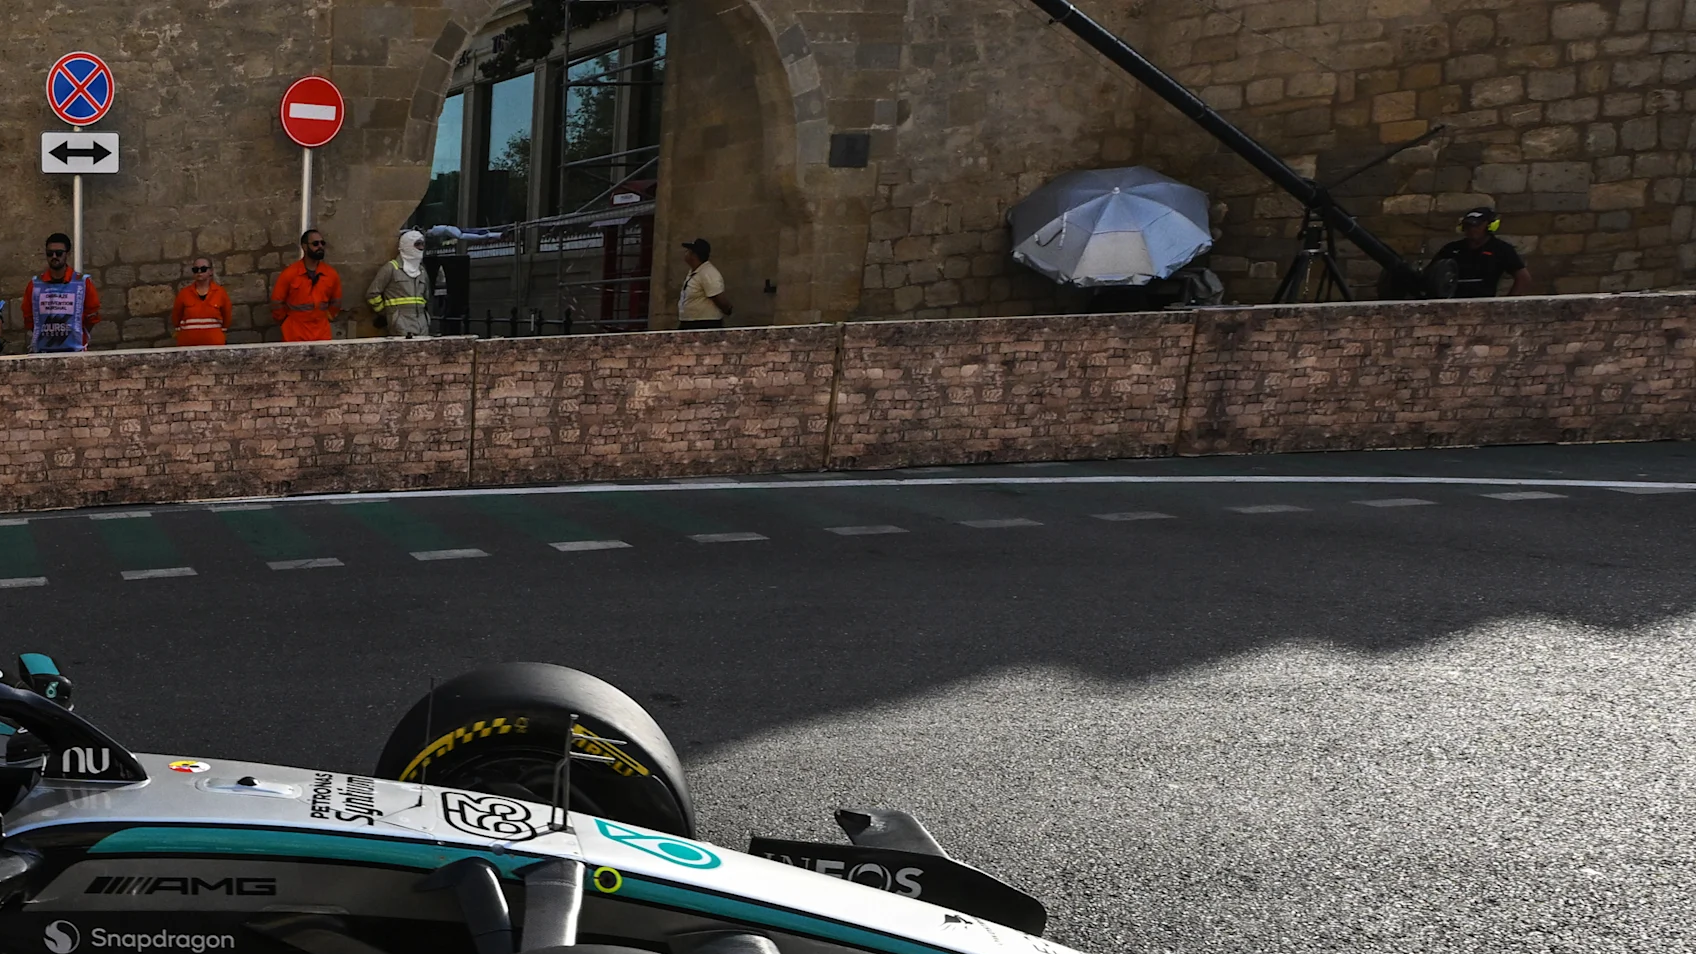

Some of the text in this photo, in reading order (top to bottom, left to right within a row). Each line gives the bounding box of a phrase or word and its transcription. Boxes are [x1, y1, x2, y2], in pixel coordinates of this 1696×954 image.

[310, 772, 334, 820] PETRONAS
[335, 776, 384, 827] Syntium
[441, 791, 537, 842] 63
[144, 876, 276, 896] AMG
[90, 926, 236, 954] Snapdragon
